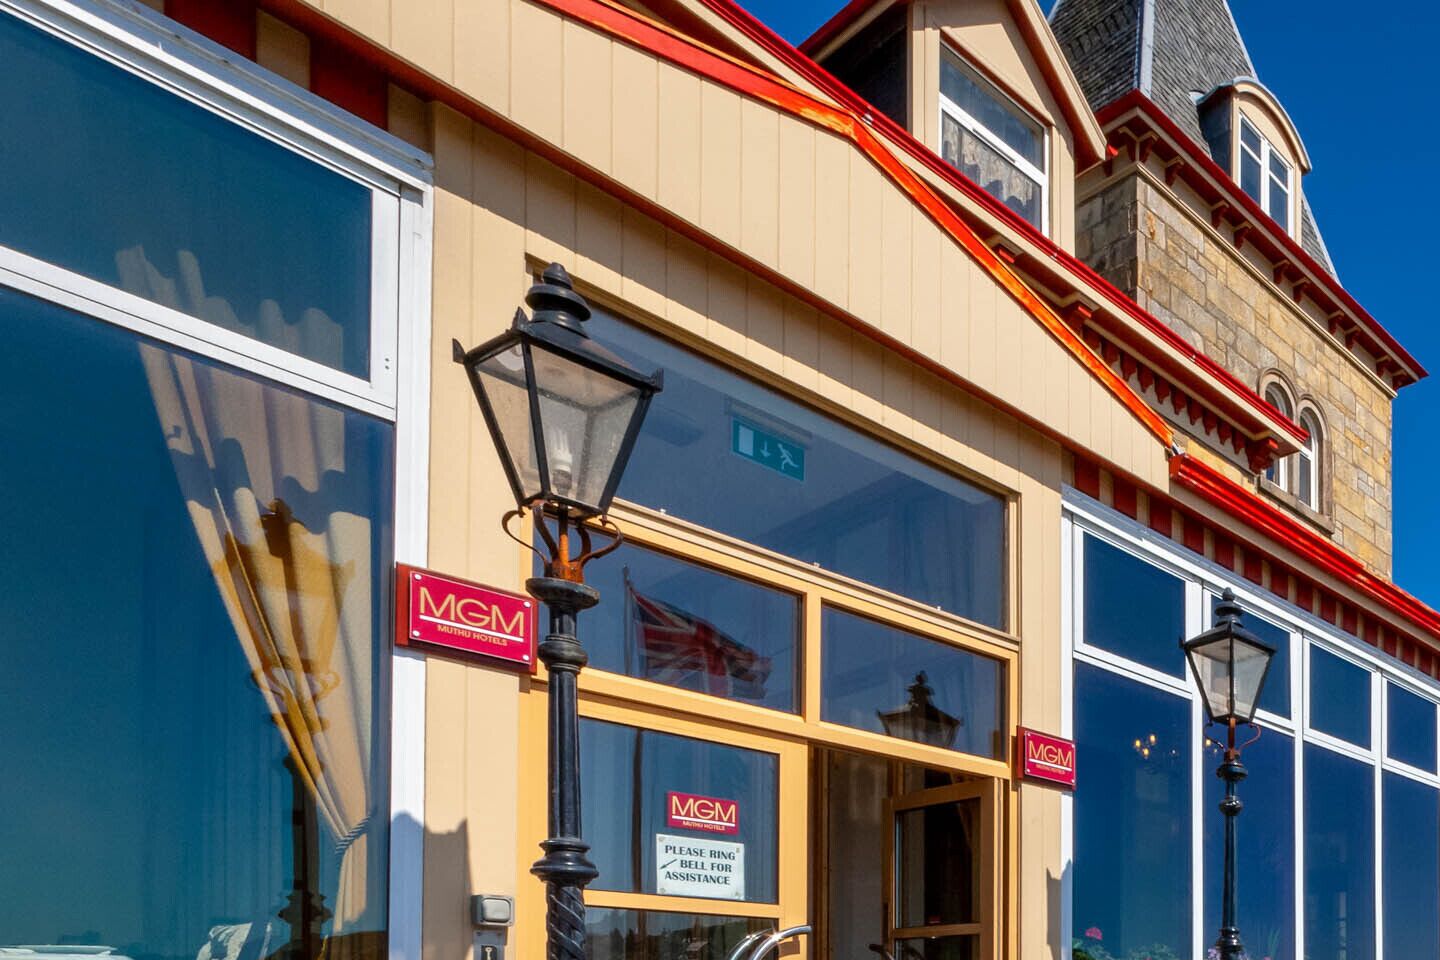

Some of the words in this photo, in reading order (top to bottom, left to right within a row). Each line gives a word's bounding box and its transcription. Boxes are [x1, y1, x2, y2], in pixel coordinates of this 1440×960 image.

[419, 587, 525, 637] MGM
[437, 624, 471, 639] MUTHU
[472, 633, 508, 646] HOTELS
[1029, 740, 1072, 768] MGM
[672, 795, 736, 823] MGM
[665, 845, 706, 858] PLEASE
[709, 850, 736, 860] RING
[680, 860, 707, 871] BELL
[710, 862, 732, 873] FOR
[664, 871, 731, 885] ASSISTANCE
